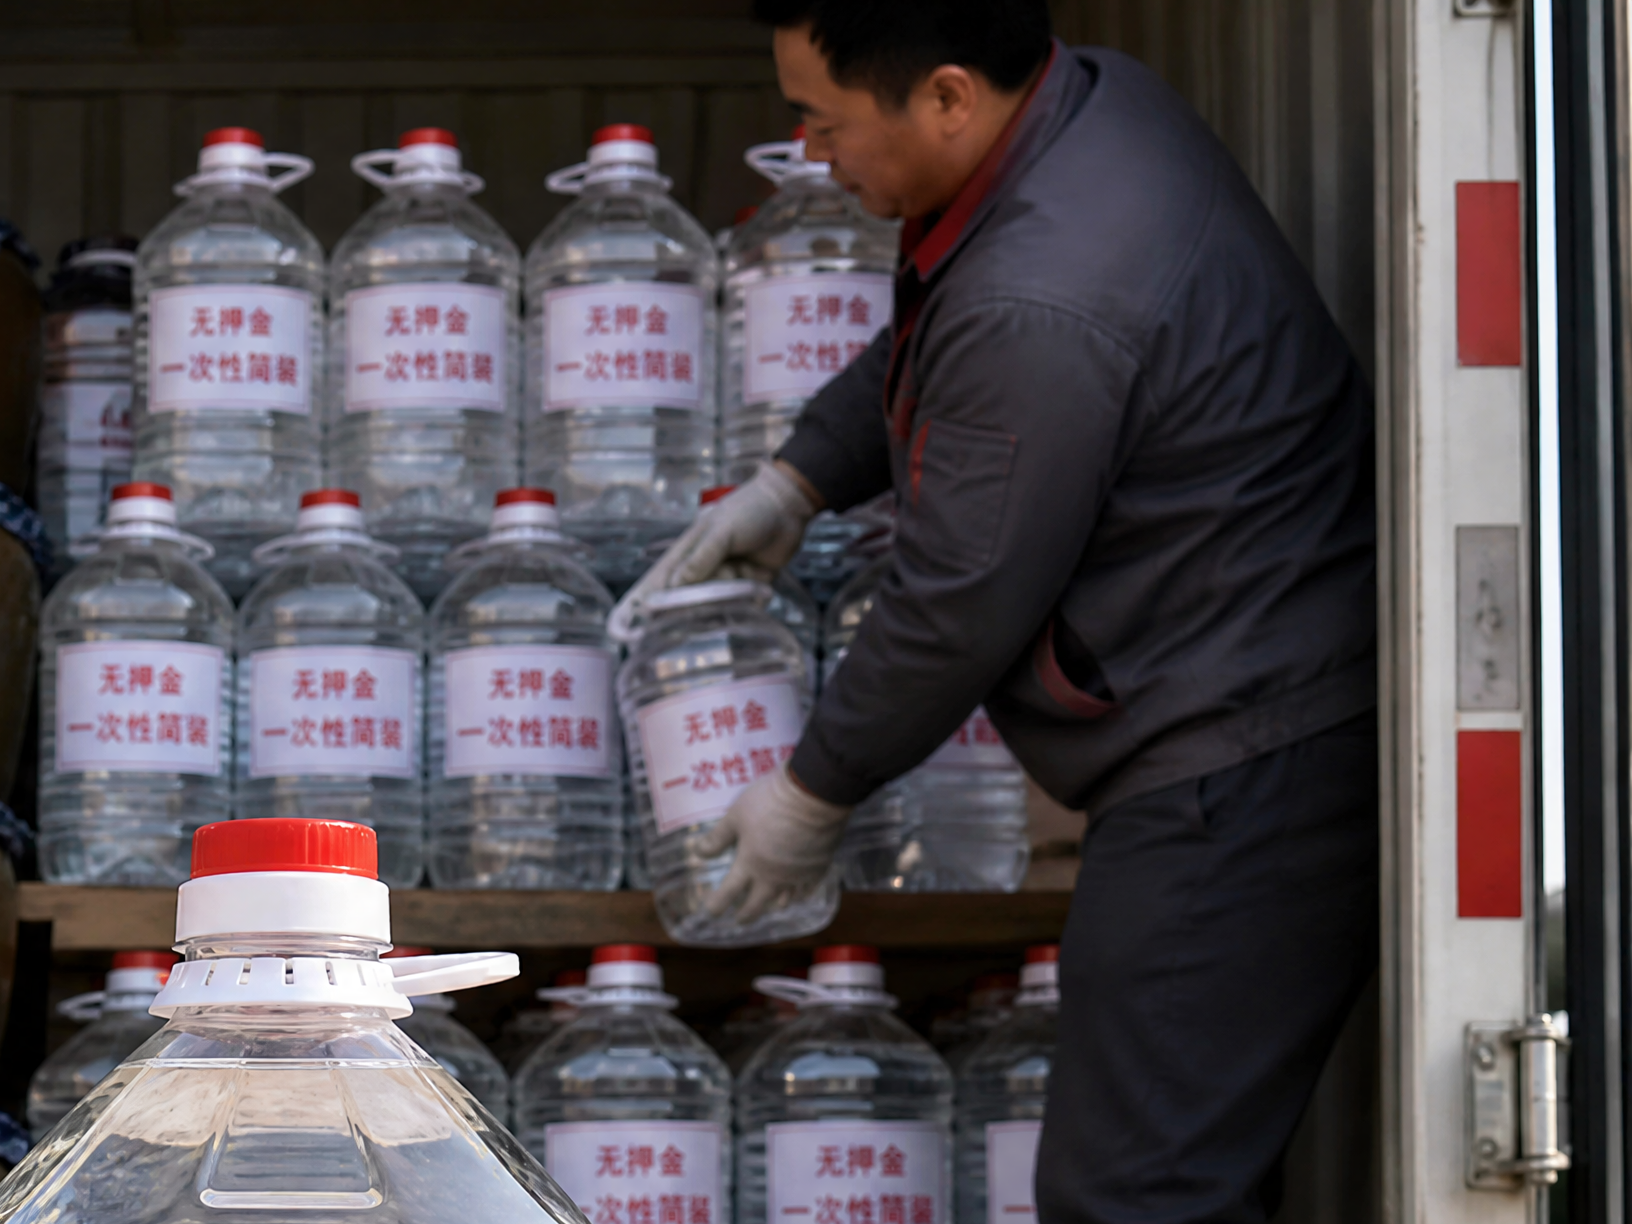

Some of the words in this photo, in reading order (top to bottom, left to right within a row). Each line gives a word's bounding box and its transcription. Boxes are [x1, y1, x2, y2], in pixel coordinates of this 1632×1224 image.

[193, 308, 270, 335] 无押金
[388, 306, 466, 334] 无押金
[589, 306, 666, 333] 无押金
[789, 296, 869, 324] 无押金
[161, 353, 296, 384] 一次性简装
[357, 351, 492, 381] 一次性简装
[557, 351, 691, 380] 一次性简装
[102, 665, 181, 694] 无押金
[295, 671, 375, 699] 无押金
[492, 670, 571, 699] 无押金
[70, 713, 207, 745] 一次性简装
[264, 717, 400, 747] 一次性简装
[459, 717, 598, 748] 一次性简装
[686, 701, 767, 744] 无押金
[599, 1146, 682, 1176] 无押金
[819, 1146, 903, 1176] 无押金
